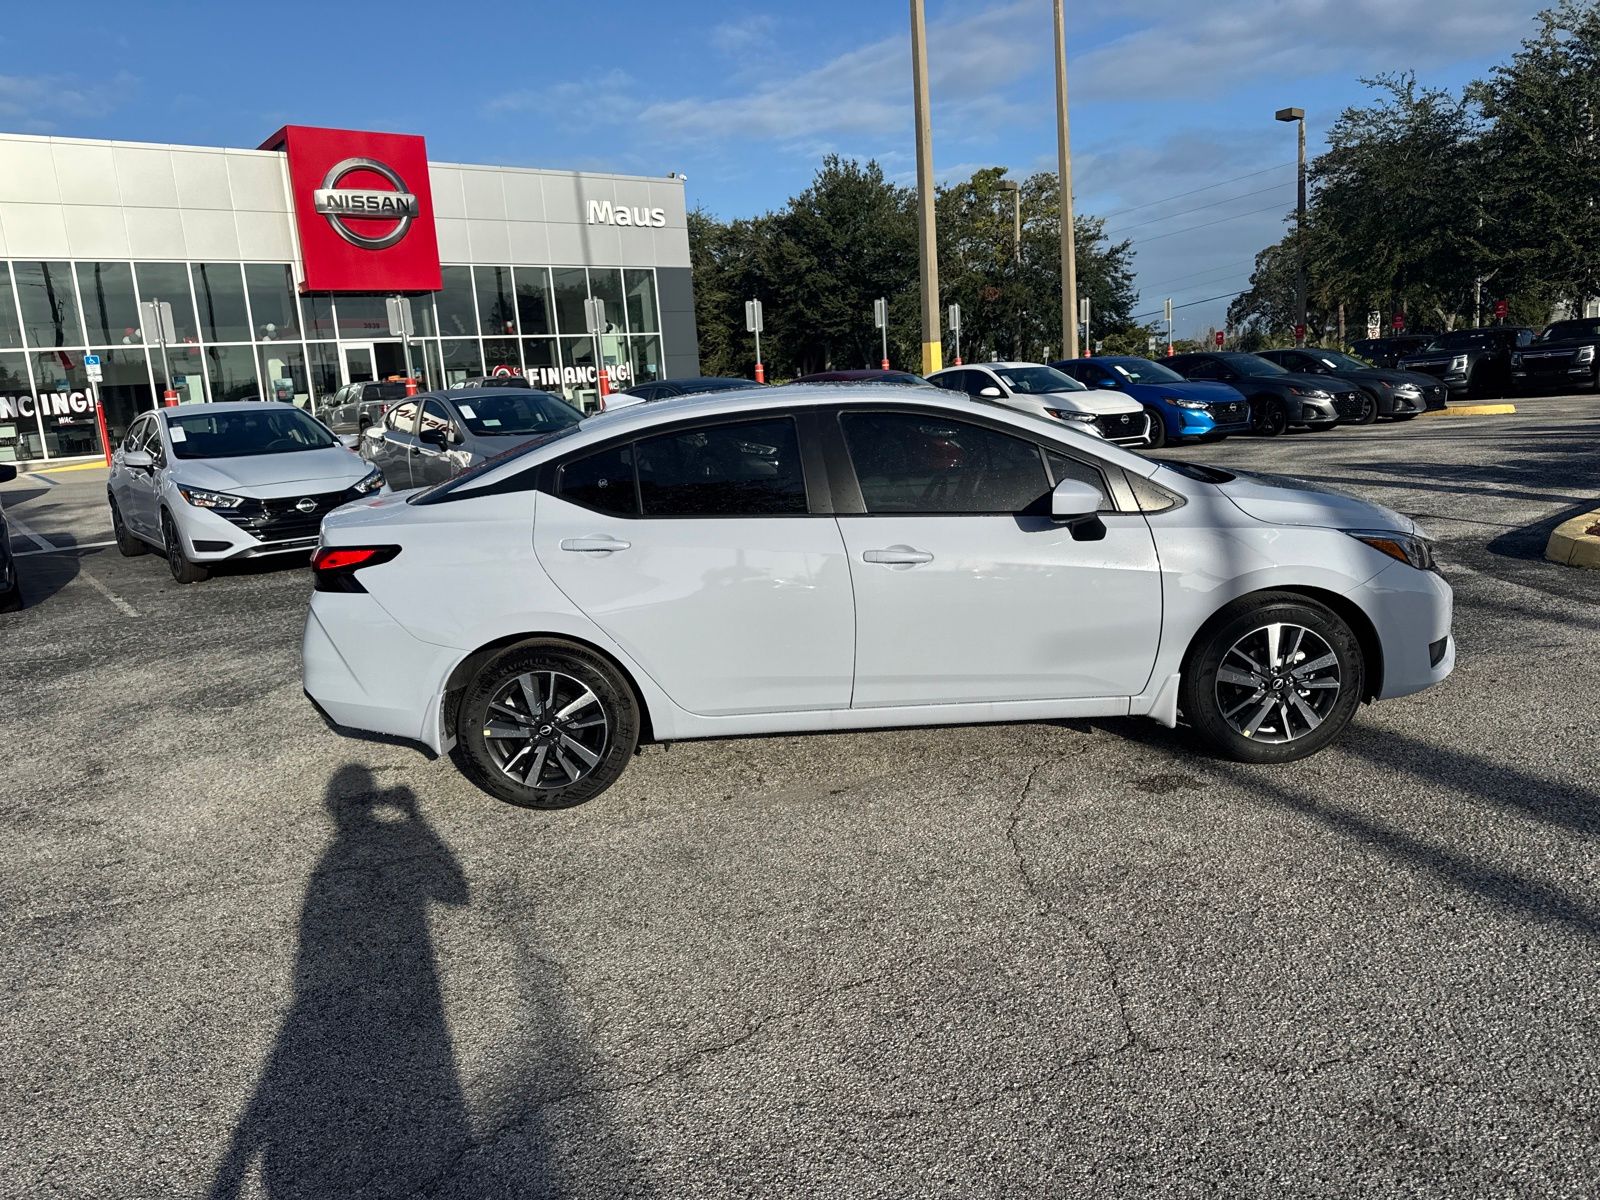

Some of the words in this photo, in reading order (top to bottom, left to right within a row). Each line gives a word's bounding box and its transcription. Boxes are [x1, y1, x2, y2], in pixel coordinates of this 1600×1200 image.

[326, 195, 410, 211] NISSAN
[587, 200, 666, 228] Maus
[528, 361, 631, 386] FINANCNG!
